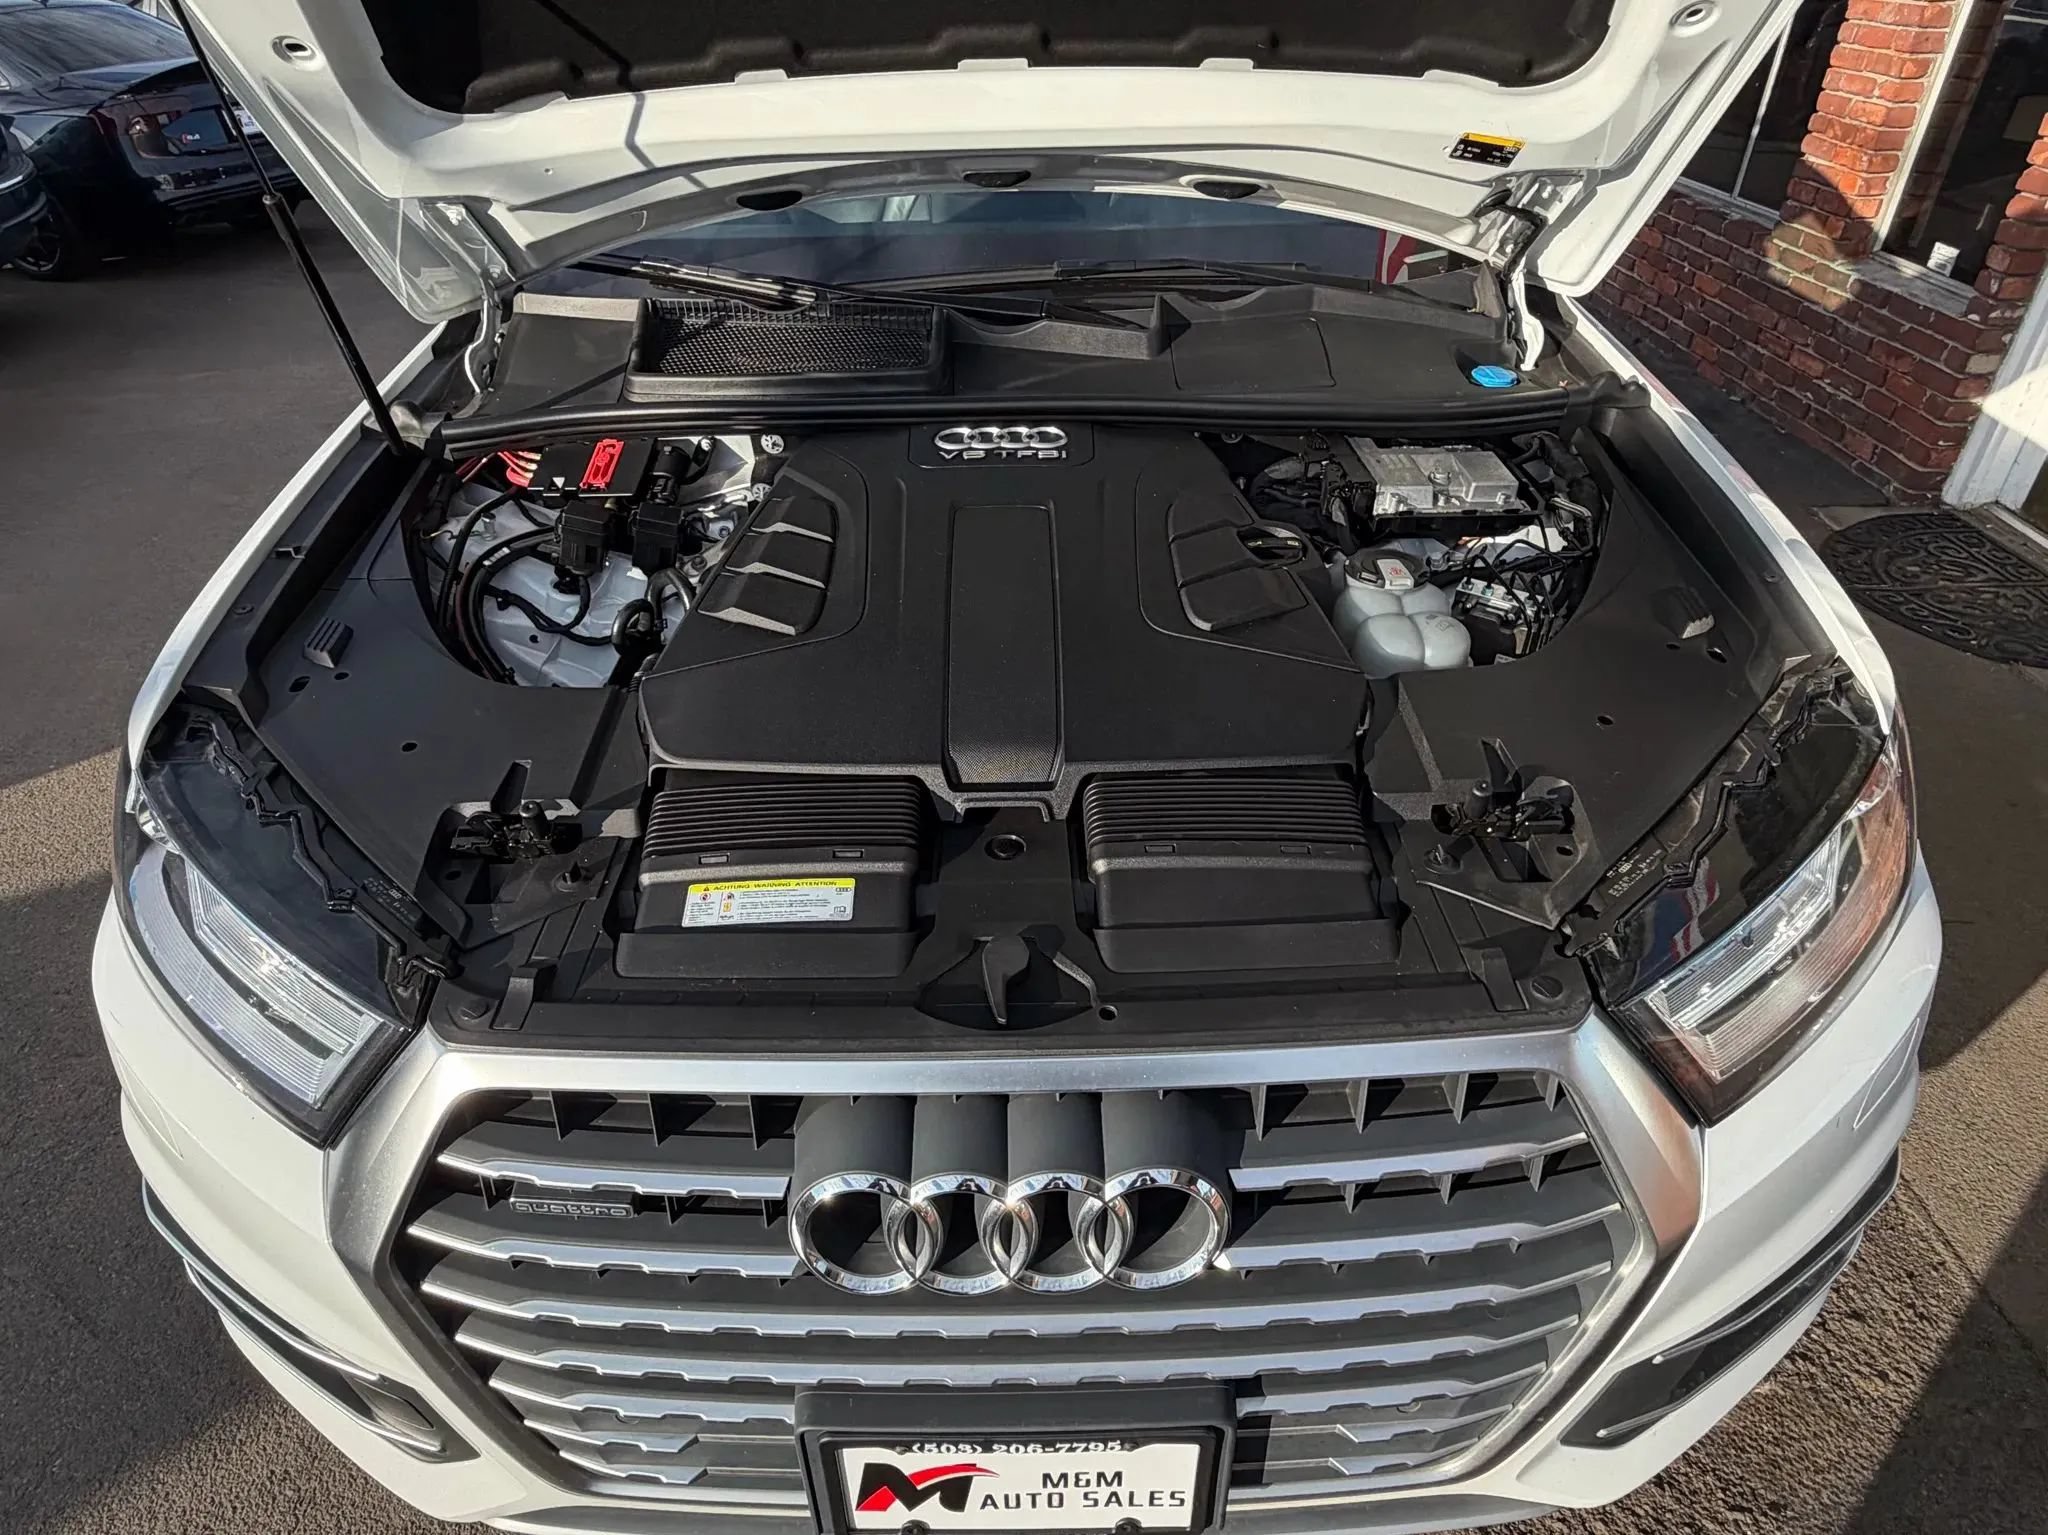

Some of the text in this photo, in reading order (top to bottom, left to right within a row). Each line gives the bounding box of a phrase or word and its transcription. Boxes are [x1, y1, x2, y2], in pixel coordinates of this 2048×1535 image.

[939, 450, 1067, 459] V6 TFSI
[713, 883, 751, 891] ACHTUNG
[515, 1202, 627, 1216] quattro
[912, 1440, 1122, 1455] (503) 206-7795
[1041, 1470, 1124, 1489] M&M
[979, 1490, 1187, 1511] AUTO SALES
